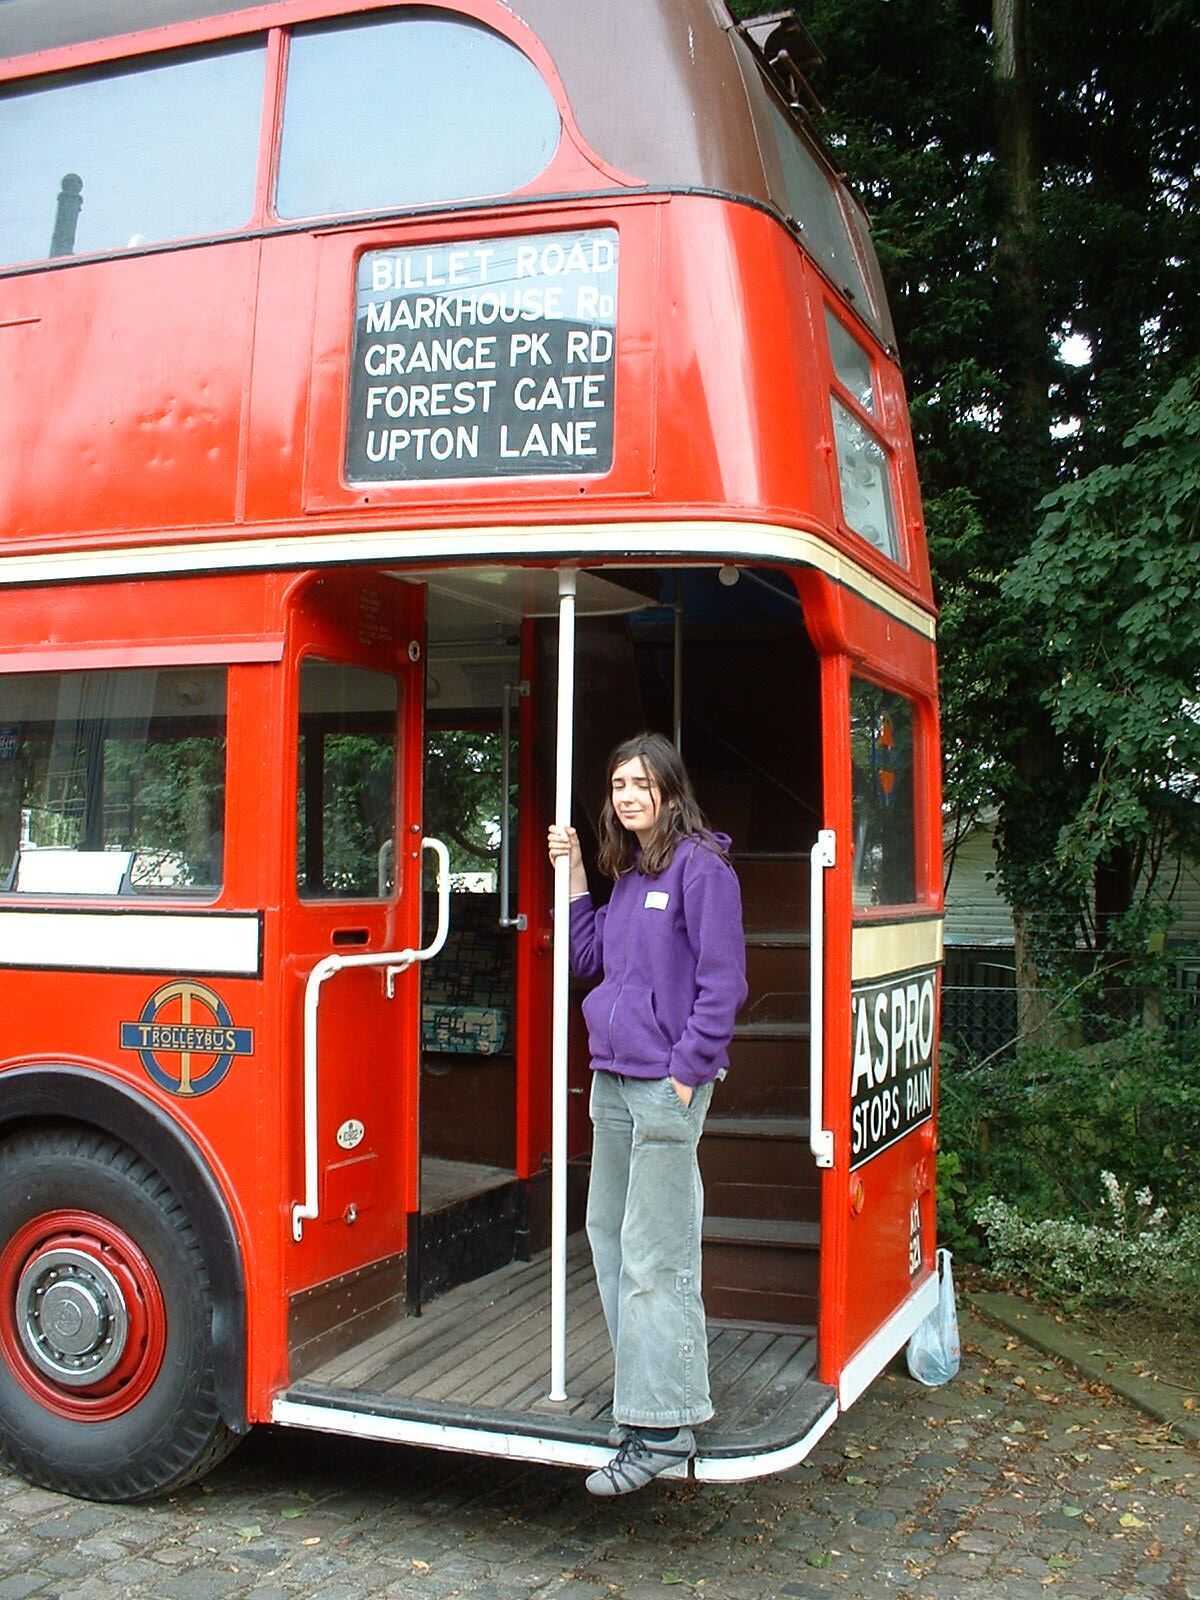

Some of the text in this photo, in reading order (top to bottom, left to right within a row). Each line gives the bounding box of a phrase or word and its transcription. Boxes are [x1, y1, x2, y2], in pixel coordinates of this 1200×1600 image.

[372, 240, 614, 291] BILLET ROAD
[366, 287, 563, 333] MARKHOUSE
[364, 330, 613, 376] GRANGE PK RD
[366, 374, 606, 419] FOREST GATE
[366, 421, 597, 462] UPTON LANE
[138, 1026, 236, 1051] TROLLEYBUS
[852, 1067, 932, 1155] STOPS PAIN
